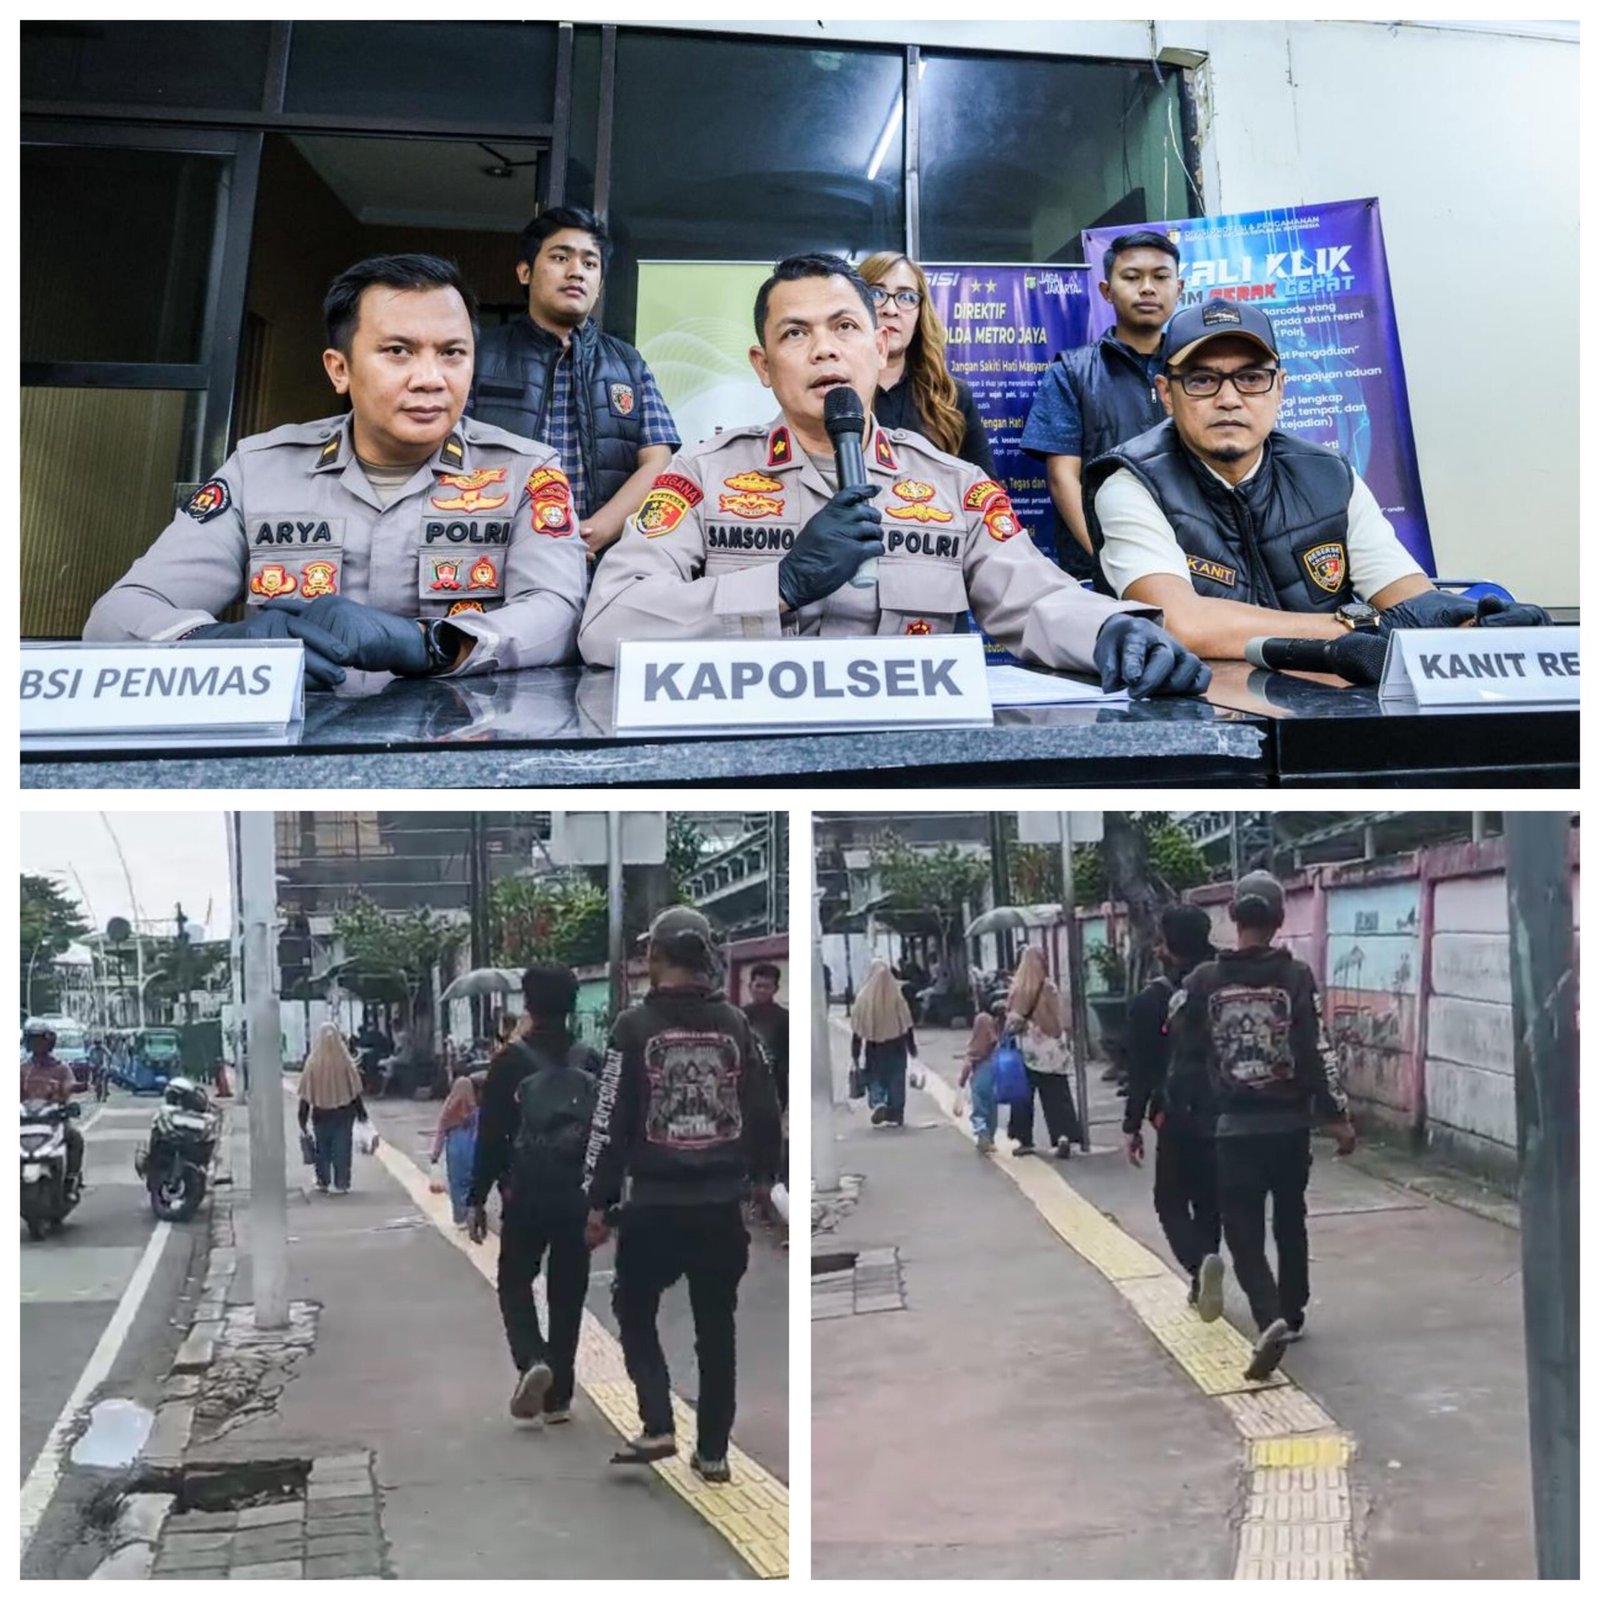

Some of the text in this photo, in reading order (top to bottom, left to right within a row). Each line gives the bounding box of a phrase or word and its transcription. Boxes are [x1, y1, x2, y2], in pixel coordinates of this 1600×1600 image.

[1257, 216, 1320, 230] PENGAMANAN
[1266, 245, 1352, 278] KLIK
[954, 303, 1007, 319] DIREKTIF
[1262, 303, 1336, 316] Barcode yang
[1274, 310, 1364, 327] pada akun resmi
[975, 327, 1015, 344] METRO
[1018, 327, 1047, 344] JAYA
[951, 361, 978, 375] Jangan
[981, 360, 1000, 371] Sakiti
[1003, 360, 1018, 371] Hati
[1284, 366, 1382, 383] pengajuan aduan
[1299, 393, 1343, 406] lengkap
[1300, 404, 1343, 416] tempat,
[1345, 403, 1367, 412] dan
[1009, 416, 1024, 428] Hati
[1281, 415, 1333, 430] kejadian)
[1009, 477, 1030, 491] Tegas
[1031, 477, 1046, 488] dan
[255, 521, 331, 545] ARYA
[426, 521, 510, 544] POLRI
[708, 524, 795, 550] SAMSONO
[888, 530, 960, 558] POLRI
[1187, 558, 1232, 581] KANIT
[1419, 652, 1580, 680] KANIT RE
[20, 665, 272, 700] BSI PENMAS
[644, 659, 963, 702] KAPOLSEK
